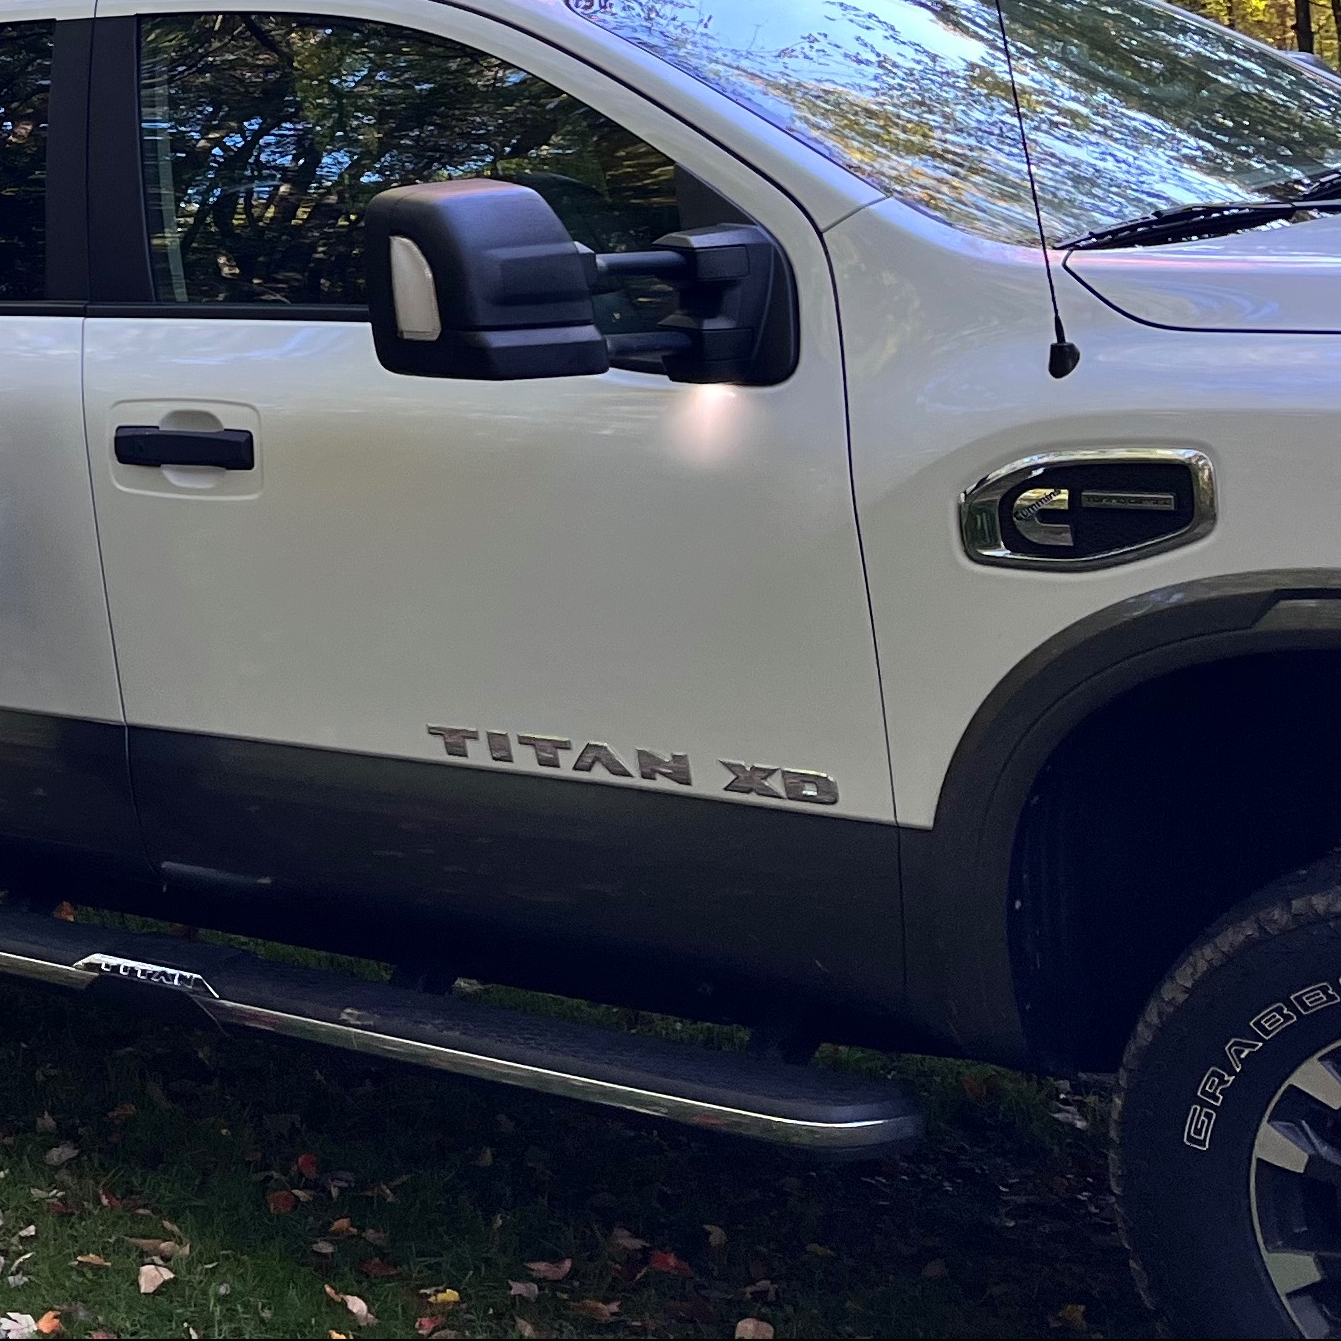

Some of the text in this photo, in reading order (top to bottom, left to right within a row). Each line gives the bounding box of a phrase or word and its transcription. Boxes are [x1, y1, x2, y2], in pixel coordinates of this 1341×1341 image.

[426, 723, 840, 806] TITAN XD
[1184, 977, 1341, 1150] GRABB
